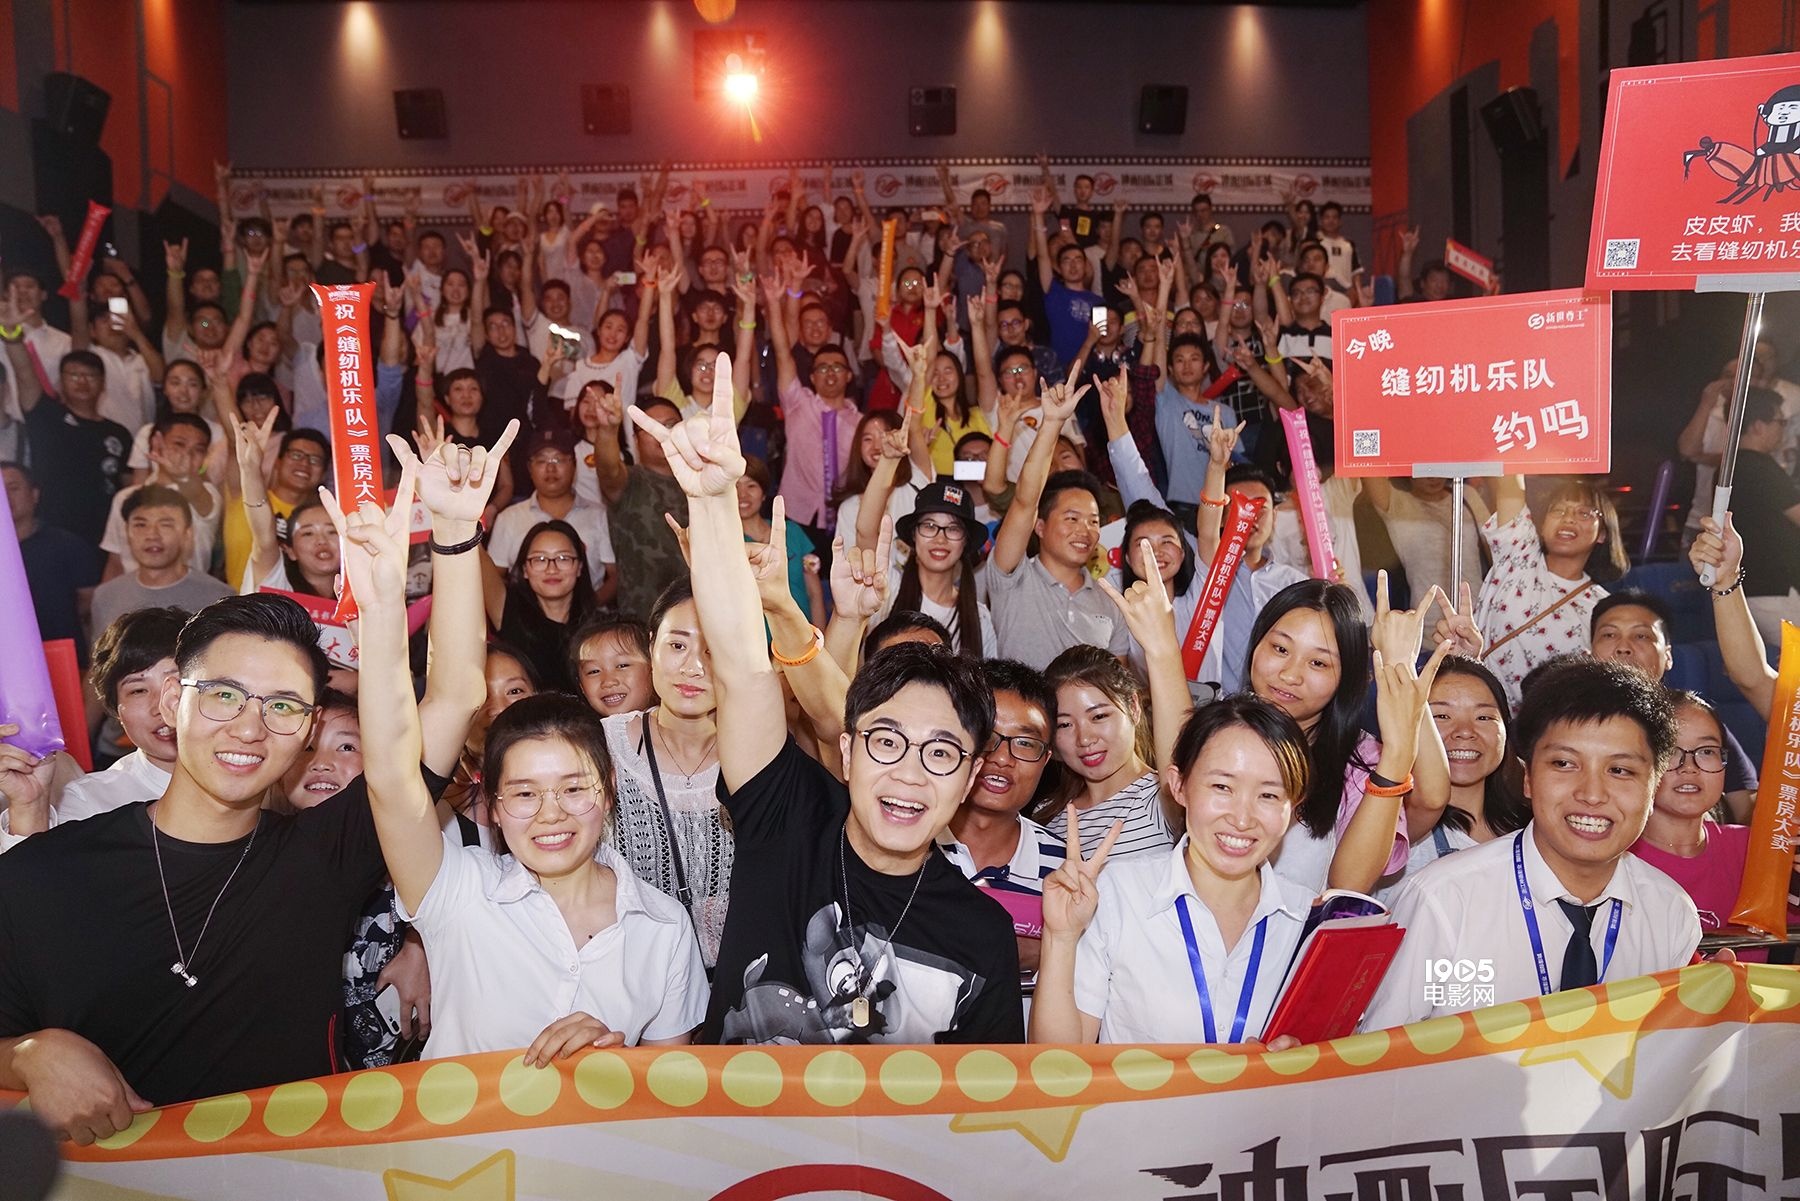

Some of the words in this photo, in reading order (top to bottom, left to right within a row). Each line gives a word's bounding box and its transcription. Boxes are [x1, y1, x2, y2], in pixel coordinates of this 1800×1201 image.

[1683, 211, 1800, 236] 皮皮虾，我
[1346, 328, 1395, 360] 今晚
[1381, 357, 1555, 397] 缝纫机乐队
[335, 303, 377, 514] 祝《缝纫机乐队》票房大
[1491, 399, 1589, 453] 约吗
